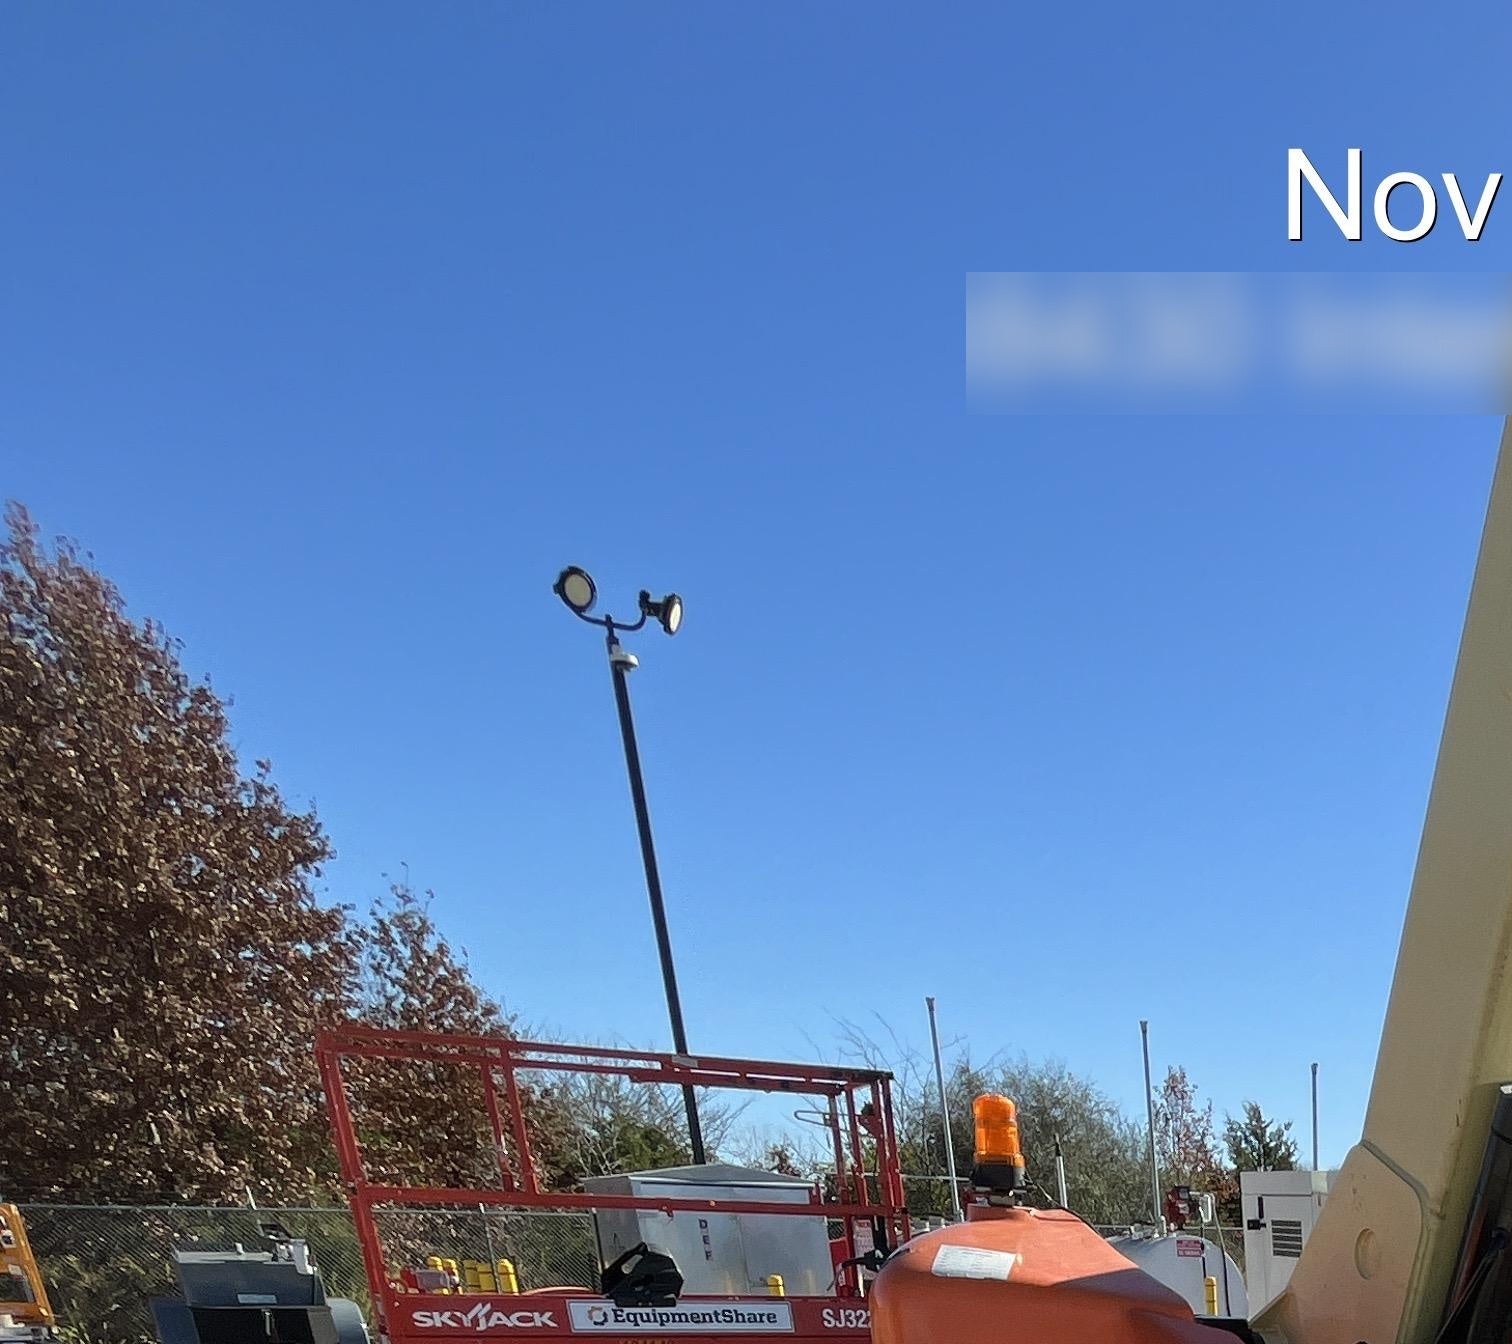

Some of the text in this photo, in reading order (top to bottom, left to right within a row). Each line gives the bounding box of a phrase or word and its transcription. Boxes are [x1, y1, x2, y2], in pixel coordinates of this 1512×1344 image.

[412, 1302, 558, 1331] SKYJACK
[612, 1308, 778, 1327] EquipmentShare
[823, 1309, 872, 1329] SJ32
